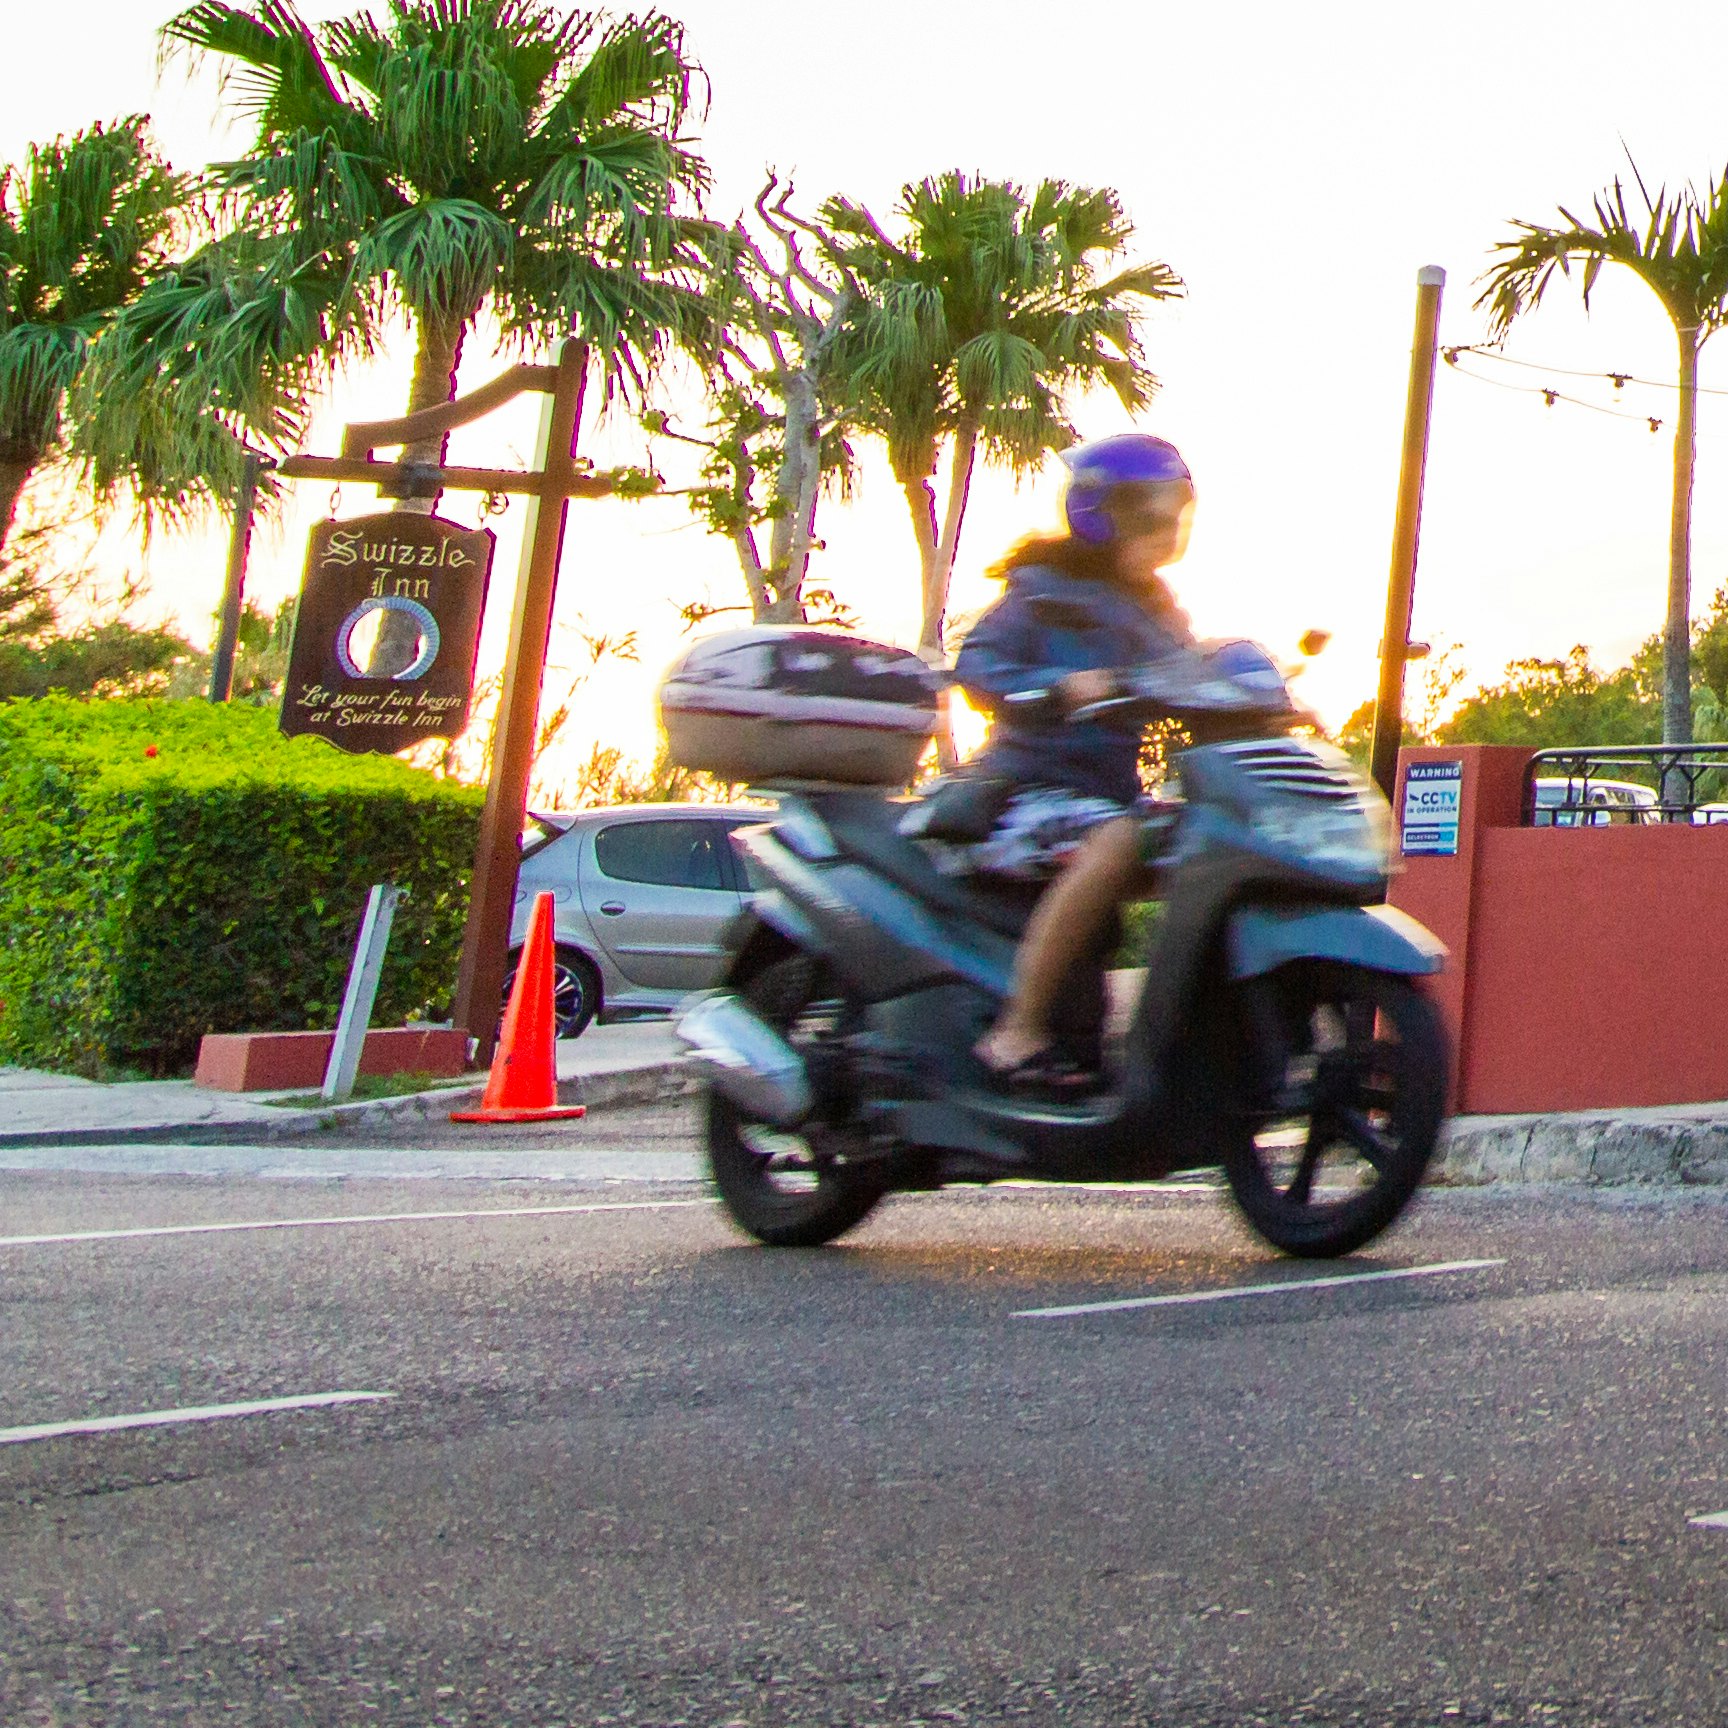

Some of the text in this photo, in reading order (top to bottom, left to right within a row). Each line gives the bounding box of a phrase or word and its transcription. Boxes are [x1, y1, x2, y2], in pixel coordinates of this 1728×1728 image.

[321, 531, 476, 569] Swizzle
[371, 568, 431, 599] Inn
[297, 683, 463, 711] Let your fun begin
[310, 709, 443, 728] at Swizzle Inn
[1410, 767, 1460, 778] WARNING
[1421, 791, 1458, 805] CCTV
[1417, 806, 1457, 814] OPERATION
